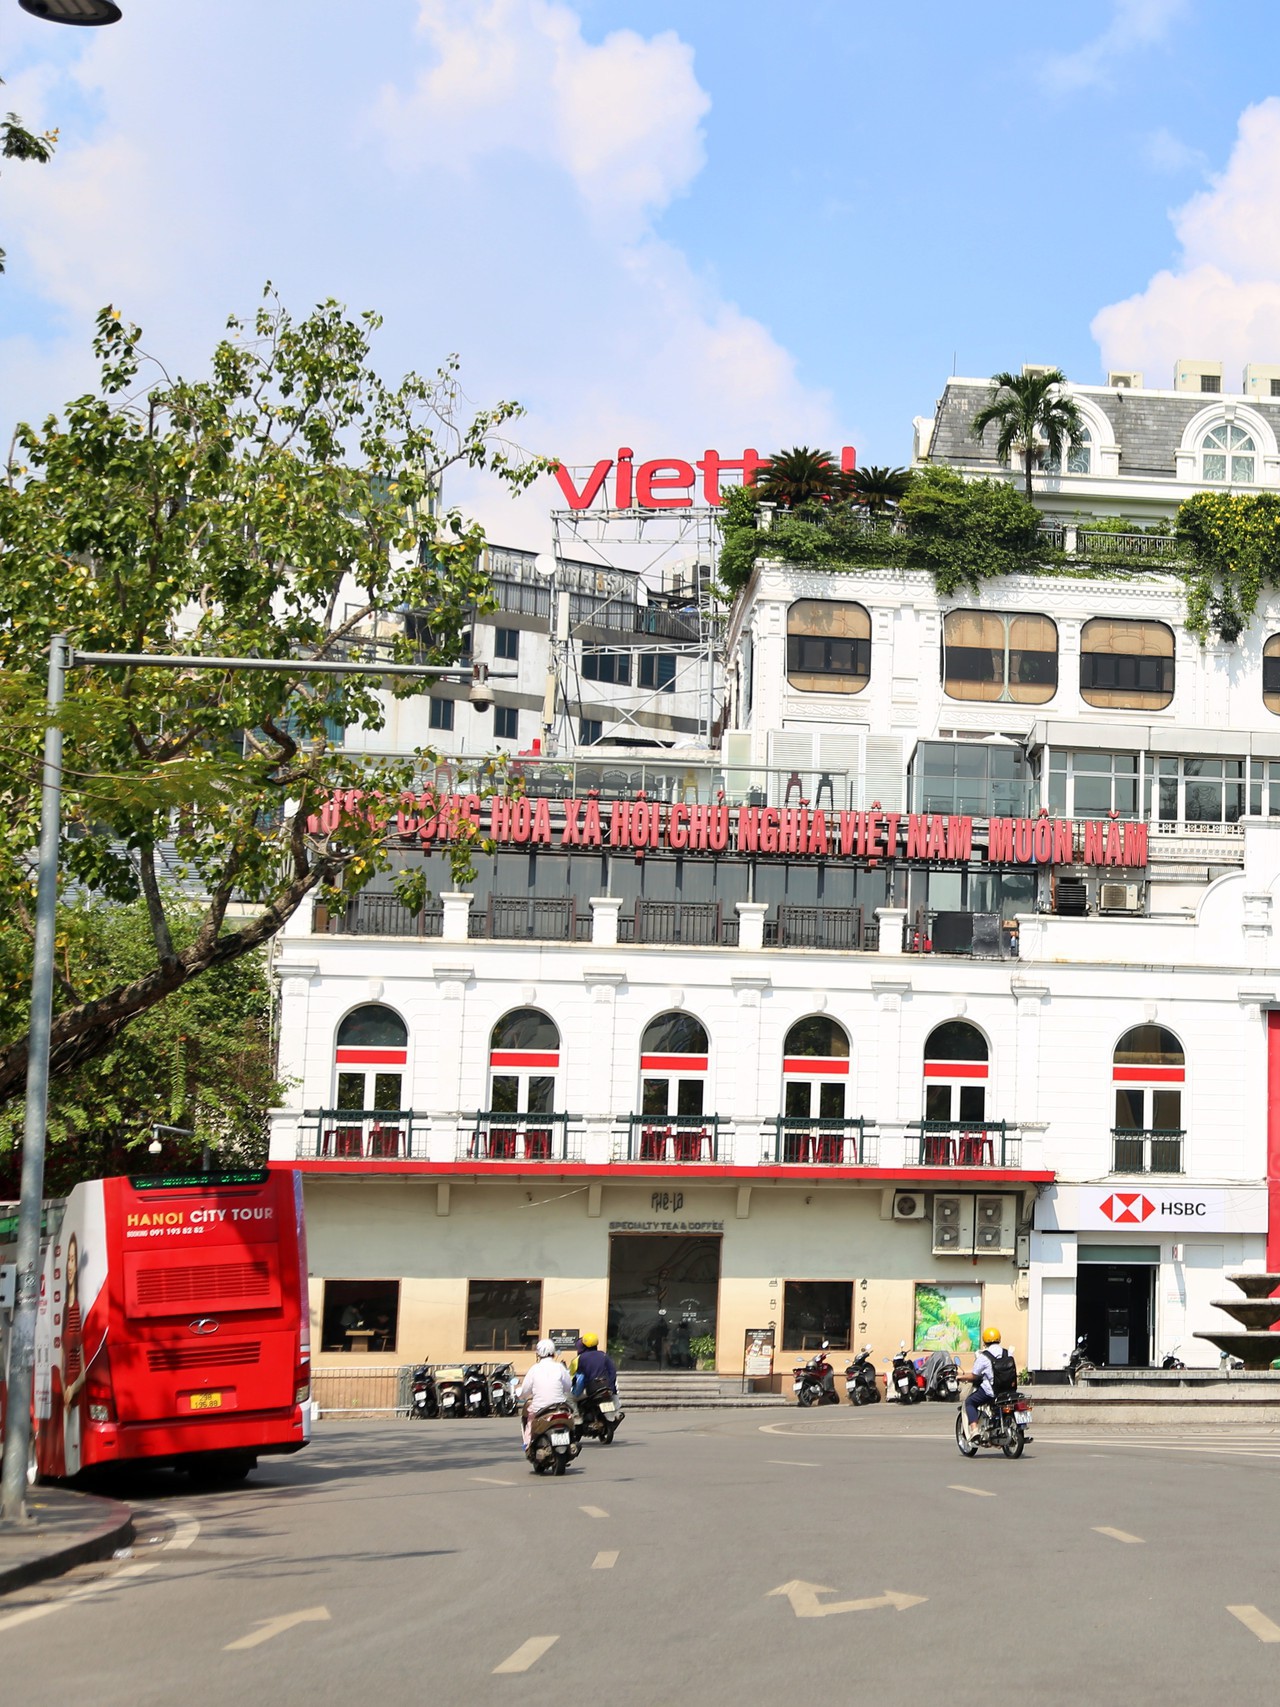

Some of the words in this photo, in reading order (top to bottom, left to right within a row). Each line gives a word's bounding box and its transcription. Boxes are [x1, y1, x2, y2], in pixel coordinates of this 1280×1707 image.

[548, 447, 856, 508] viettl
[561, 789, 601, 845] XÃ
[610, 790, 660, 858] HỘI
[669, 790, 729, 850] CHỦ
[739, 797, 828, 855] NGHĨA
[840, 800, 900, 866] VIỆT
[907, 814, 972, 861] NAM
[988, 808, 1073, 865] MUÔN
[1084, 810, 1147, 867] NĂM
[127, 1211, 184, 1226] HANOI
[189, 1208, 227, 1223] CITY
[231, 1207, 273, 1221] TOUR
[1161, 1202, 1207, 1216] HSBC
[149, 1228, 164, 1236] 091
[166, 1227, 180, 1236] 193
[182, 1226, 192, 1235] 82
[193, 1226, 204, 1234] 82
[609, 1221, 659, 1230] SPECIALTY
[661, 1221, 679, 1230] TEA
[680, 1222, 687, 1230] &
[688, 1220, 724, 1231] COFFEE
